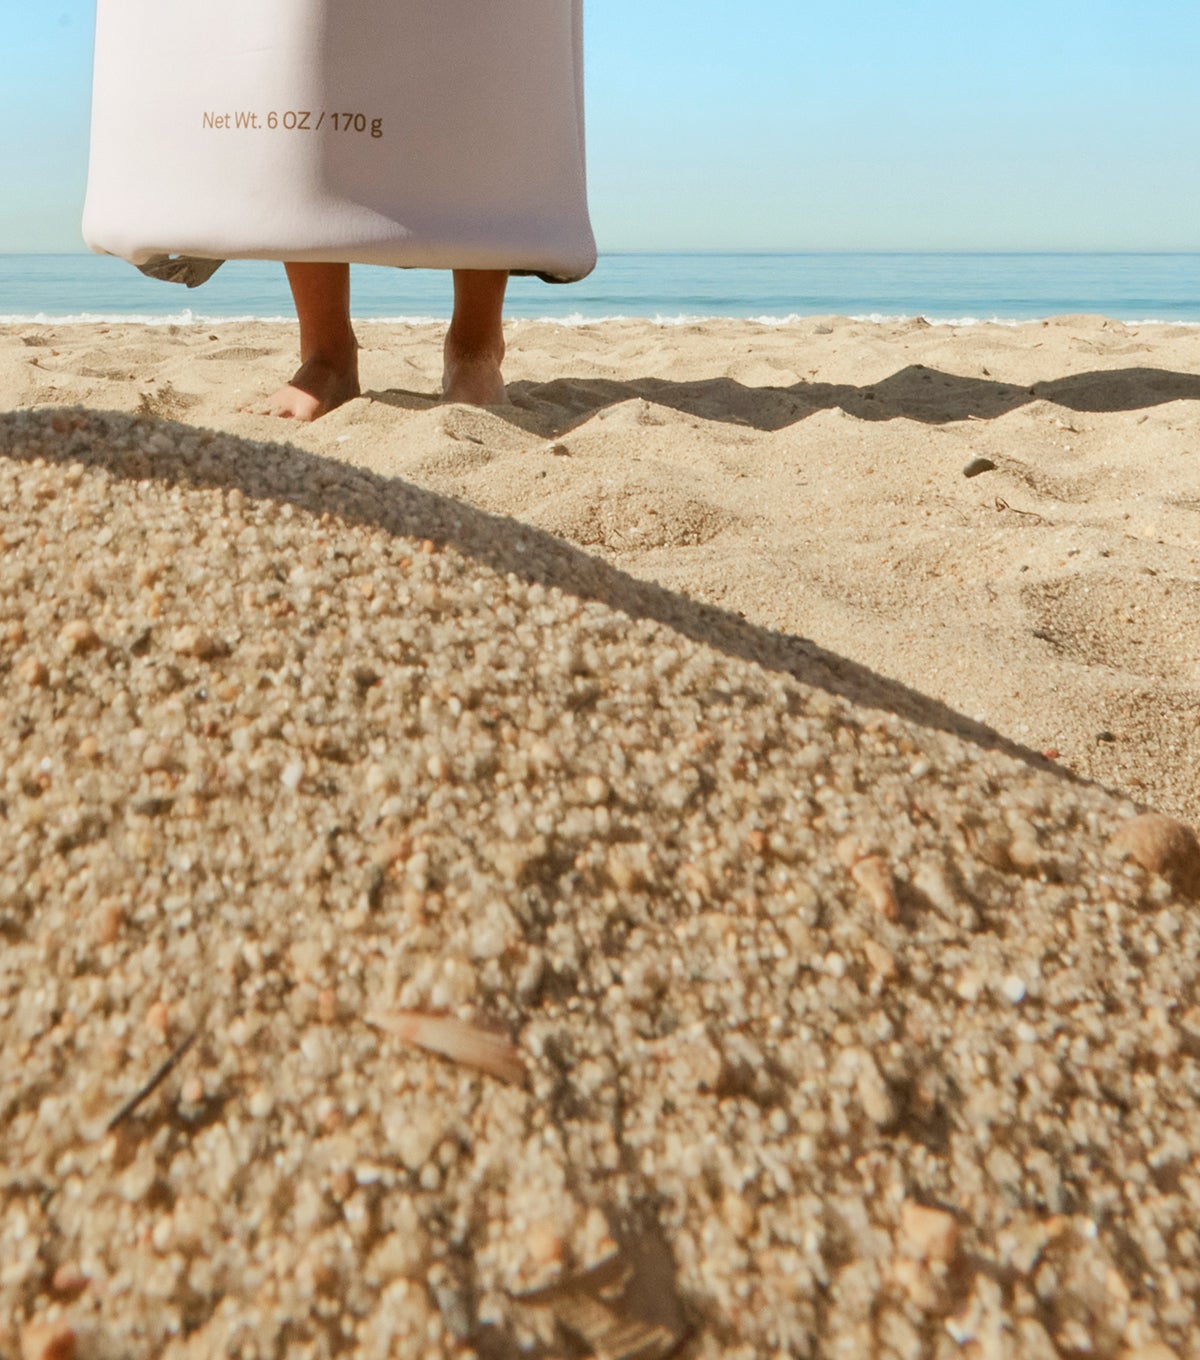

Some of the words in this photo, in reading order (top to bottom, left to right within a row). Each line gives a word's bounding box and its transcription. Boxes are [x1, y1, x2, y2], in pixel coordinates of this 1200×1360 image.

[203, 112, 230, 129] Net
[235, 111, 261, 129] Wt.
[267, 111, 278, 129] 6
[283, 111, 311, 130] OZ
[331, 113, 366, 132] 170
[371, 118, 383, 138] g
